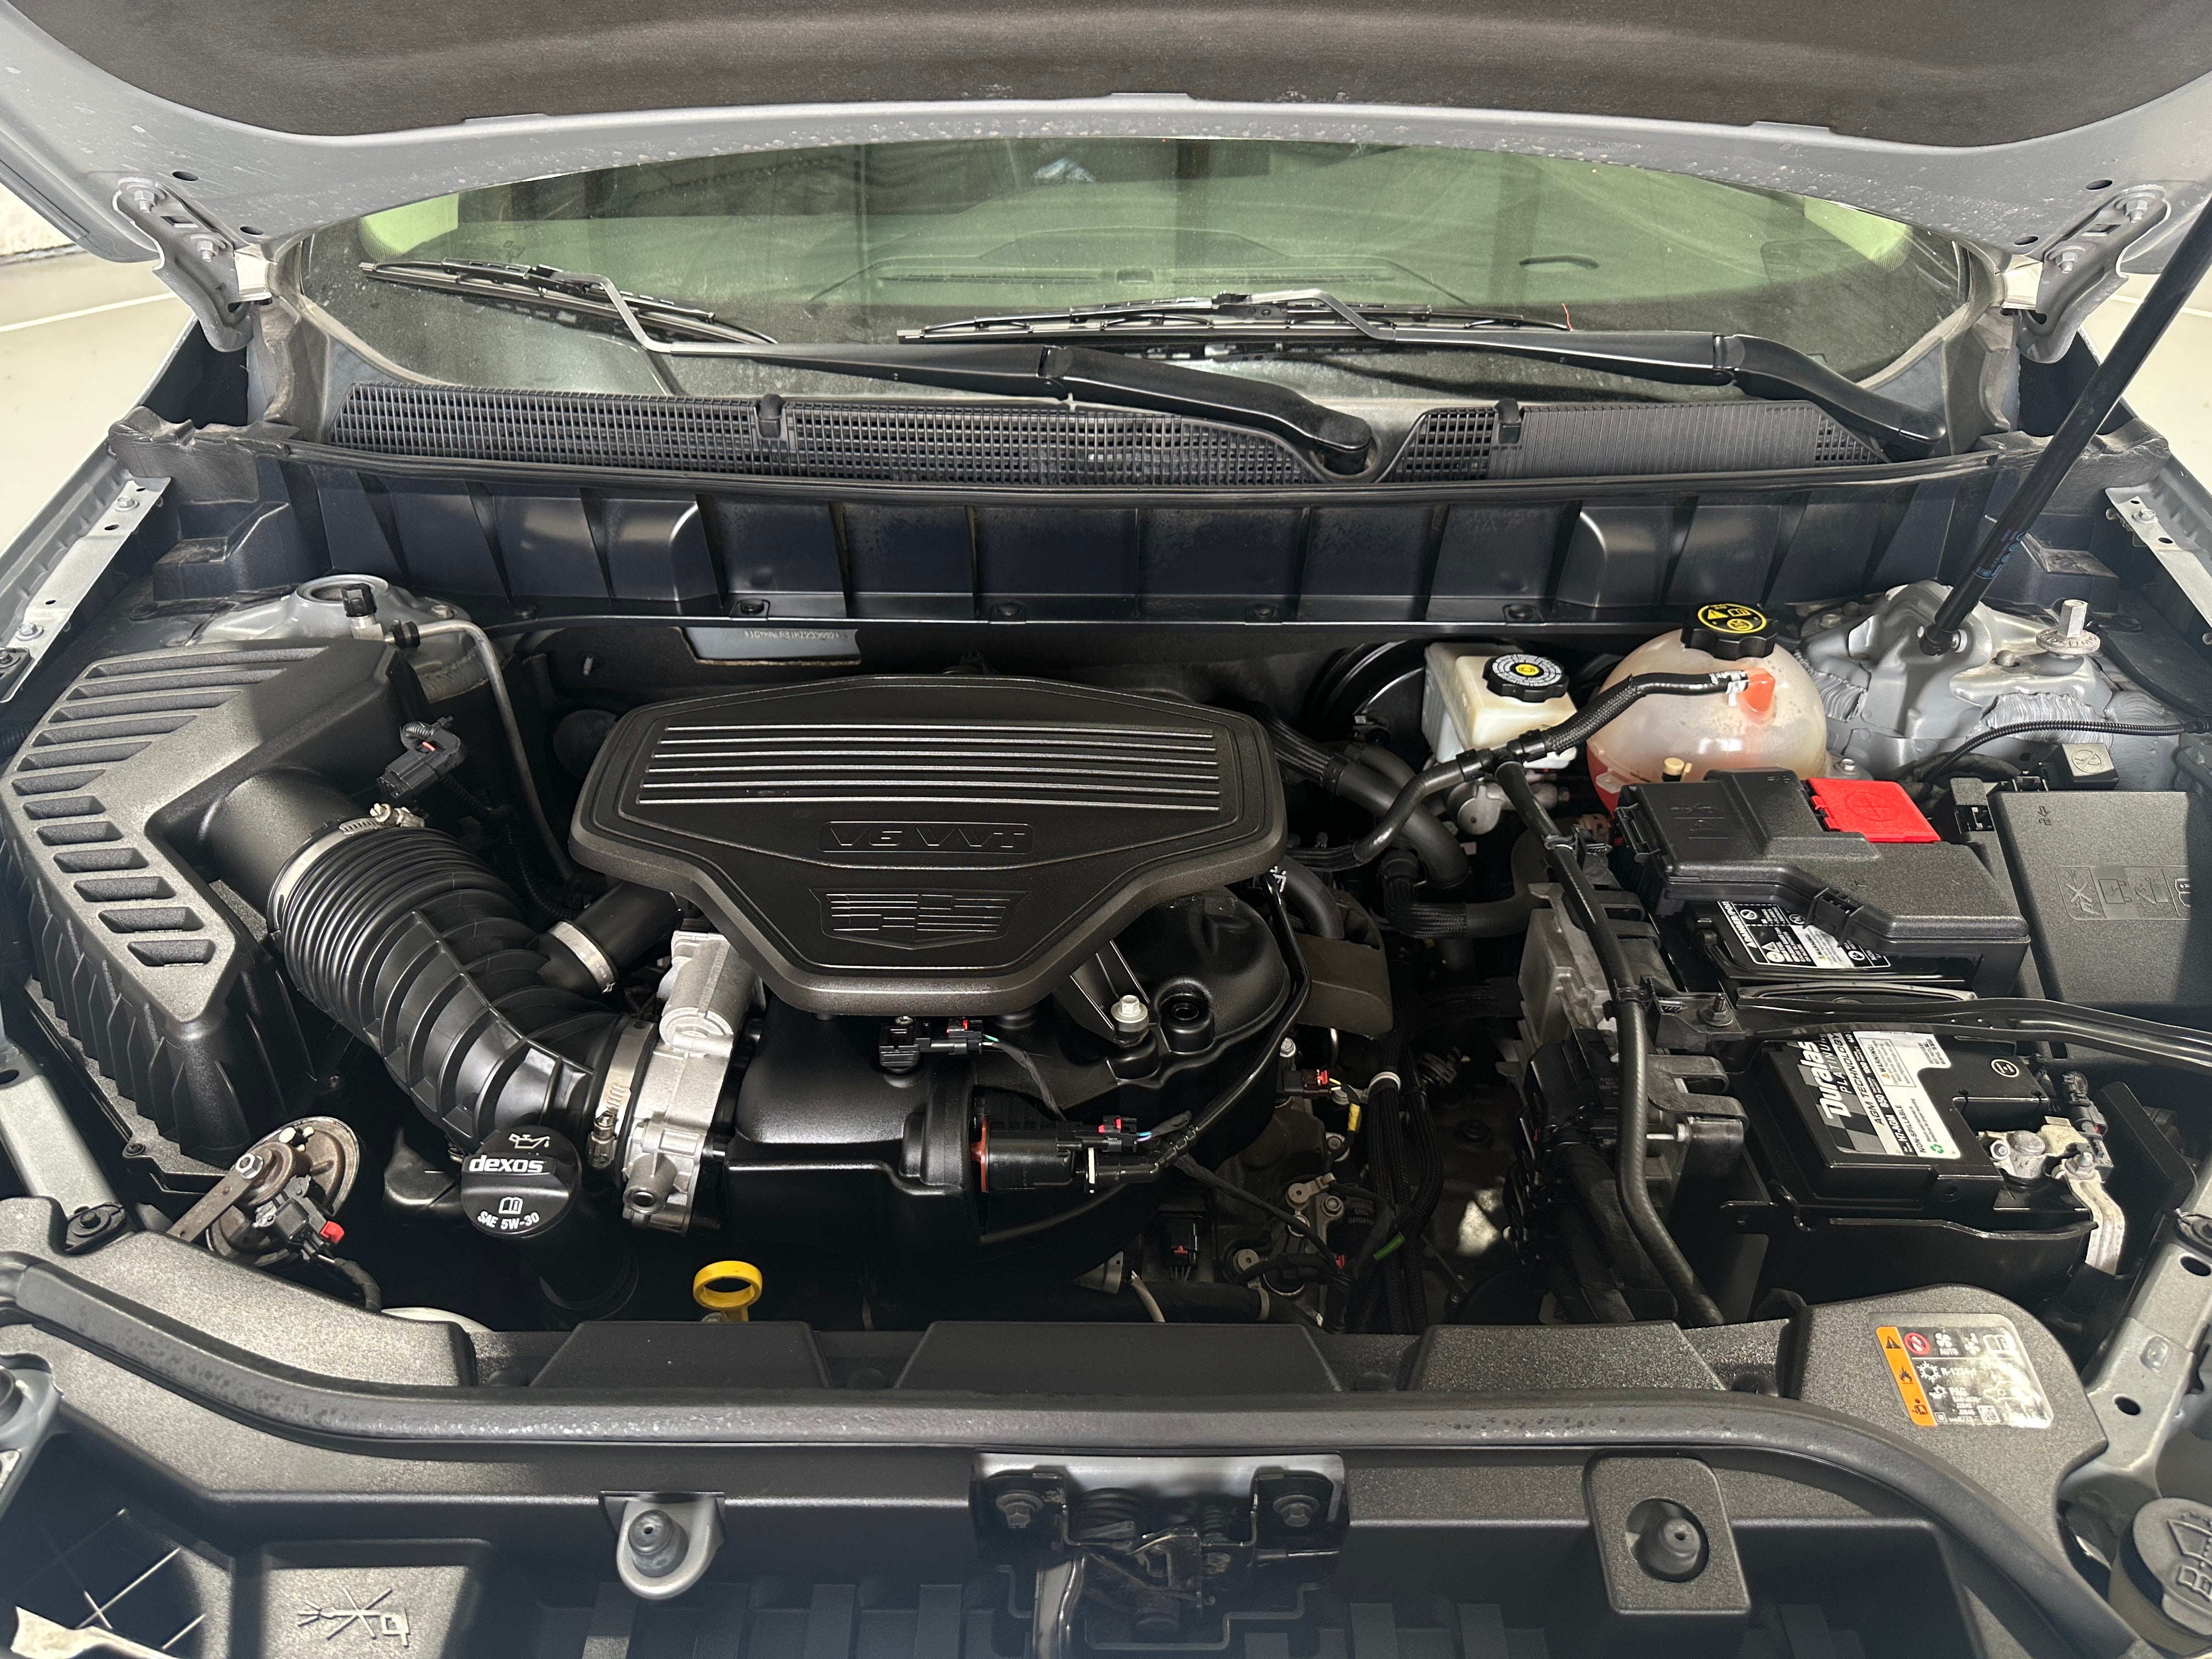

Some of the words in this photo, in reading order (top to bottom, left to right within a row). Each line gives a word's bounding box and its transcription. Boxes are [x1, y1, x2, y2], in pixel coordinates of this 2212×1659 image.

[1831, 1032, 1871, 1098] TECHNOLOGY
[1797, 1041, 1852, 1119] Duralas
[1868, 1101, 1883, 1125] AGM
[1875, 1094, 1889, 1108] 850
[1885, 1114, 1907, 1142] H7-AGM
[1895, 1104, 1927, 1153] NON-SPILLABLE
[469, 1154, 544, 1173] dexos
[477, 1211, 499, 1228] SAE
[500, 1212, 540, 1230] 5W-30
